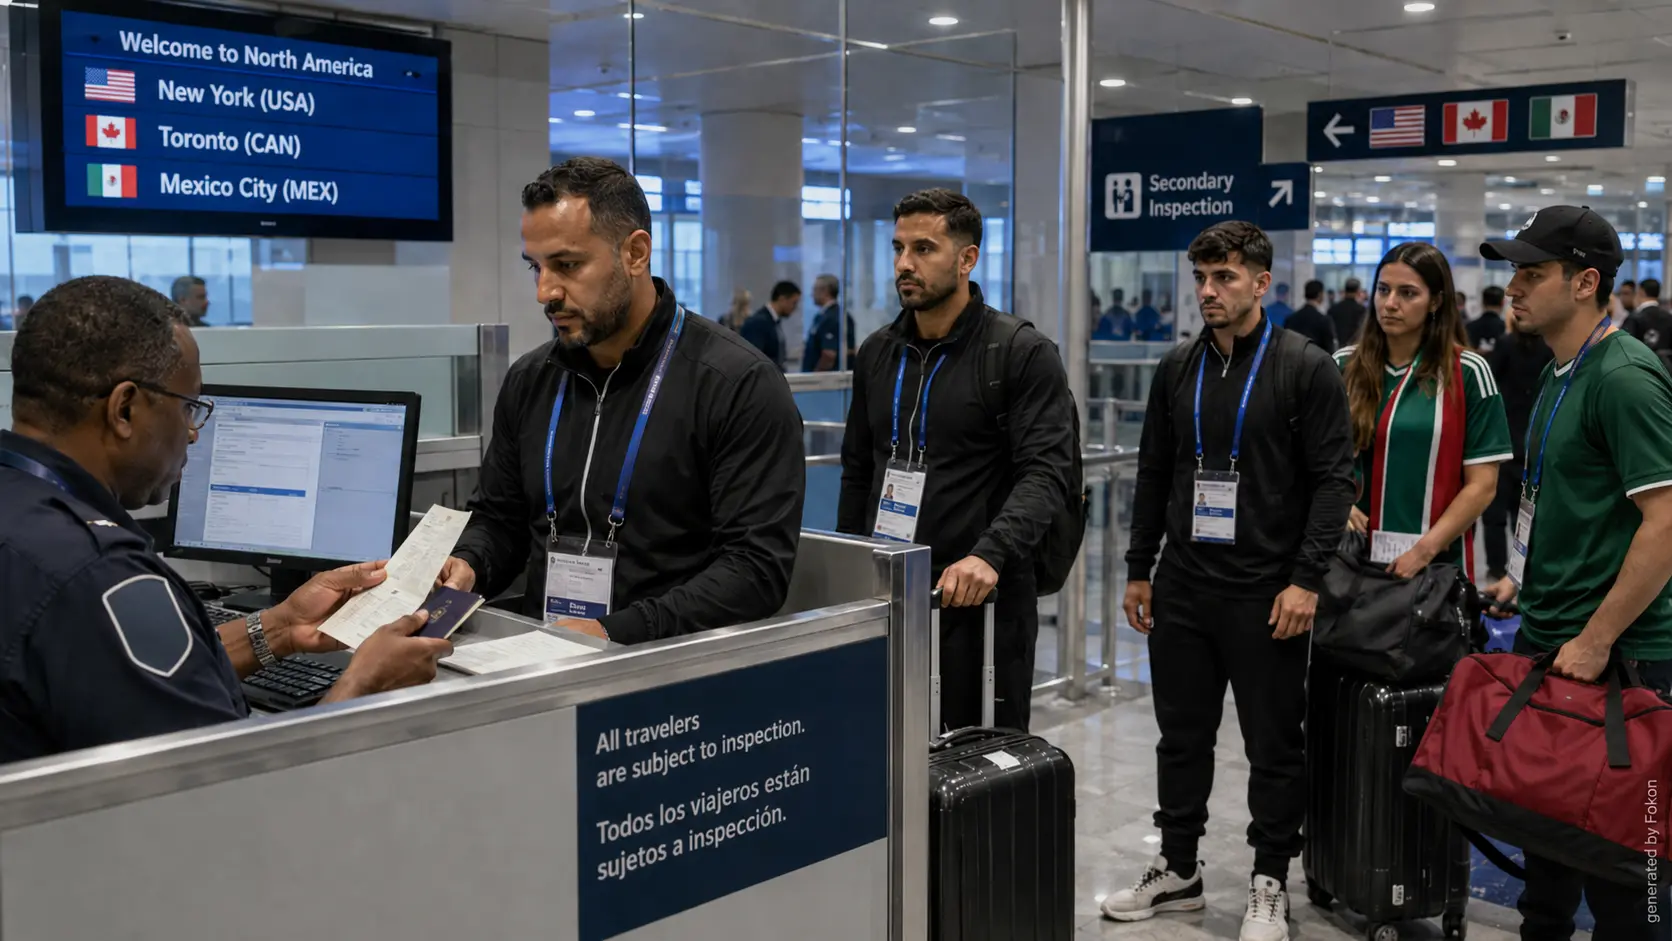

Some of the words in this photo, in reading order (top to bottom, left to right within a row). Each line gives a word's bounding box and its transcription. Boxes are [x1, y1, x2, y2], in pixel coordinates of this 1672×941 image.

[119, 30, 213, 60] Welcome
[218, 44, 239, 63] to
[244, 45, 298, 70] North
[302, 53, 373, 78] America
[158, 79, 205, 103] New
[209, 84, 255, 108] York
[260, 88, 315, 117] (USA)
[158, 125, 239, 151] Toronto
[244, 131, 301, 159] (CAN)
[160, 172, 234, 197] Mexico
[239, 177, 278, 203] City
[283, 178, 339, 205] (MEX)
[1149, 171, 1234, 193] Secondary
[1149, 196, 1233, 220] Inspection
[596, 728, 619, 755] All
[625, 714, 700, 747] travelers
[596, 765, 627, 788] are
[632, 744, 696, 779] subject
[700, 741, 717, 760] to
[722, 719, 805, 754] inspection.
[596, 812, 654, 844] Todos
[659, 803, 686, 826] los
[691, 780, 759, 816] viajeros
[764, 764, 810, 794] están
[597, 842, 667, 880] sujetos
[672, 838, 683, 857] a
[689, 804, 786, 852] inspección.
